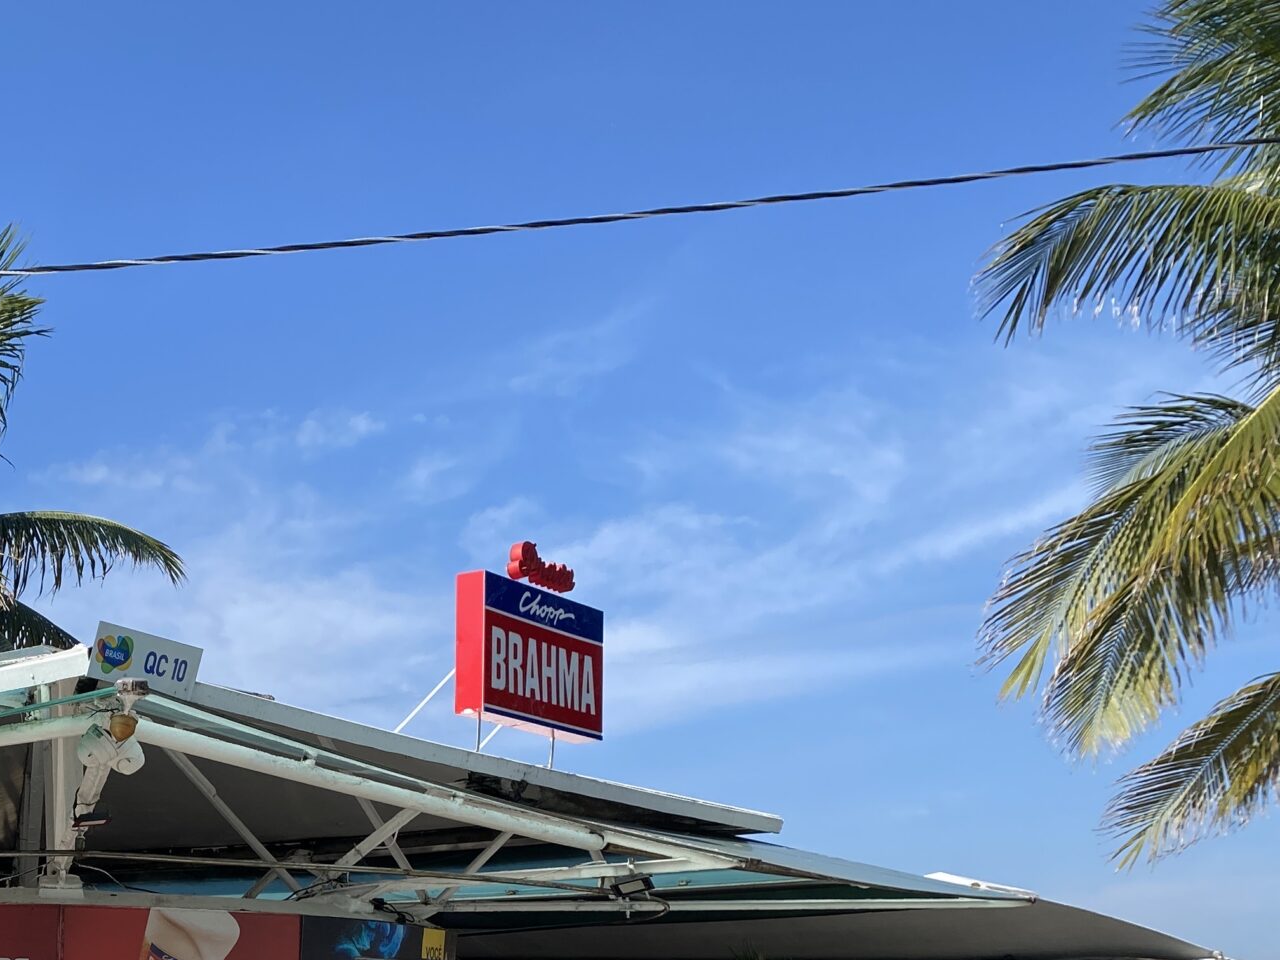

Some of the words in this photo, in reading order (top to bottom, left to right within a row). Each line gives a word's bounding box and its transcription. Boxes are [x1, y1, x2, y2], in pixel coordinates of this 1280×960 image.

[519, 591, 575, 625] Chopp
[105, 649, 125, 660] BRASIL
[144, 651, 169, 677] QC
[171, 658, 188, 682] 10
[491, 625, 596, 715] BRAHMA
